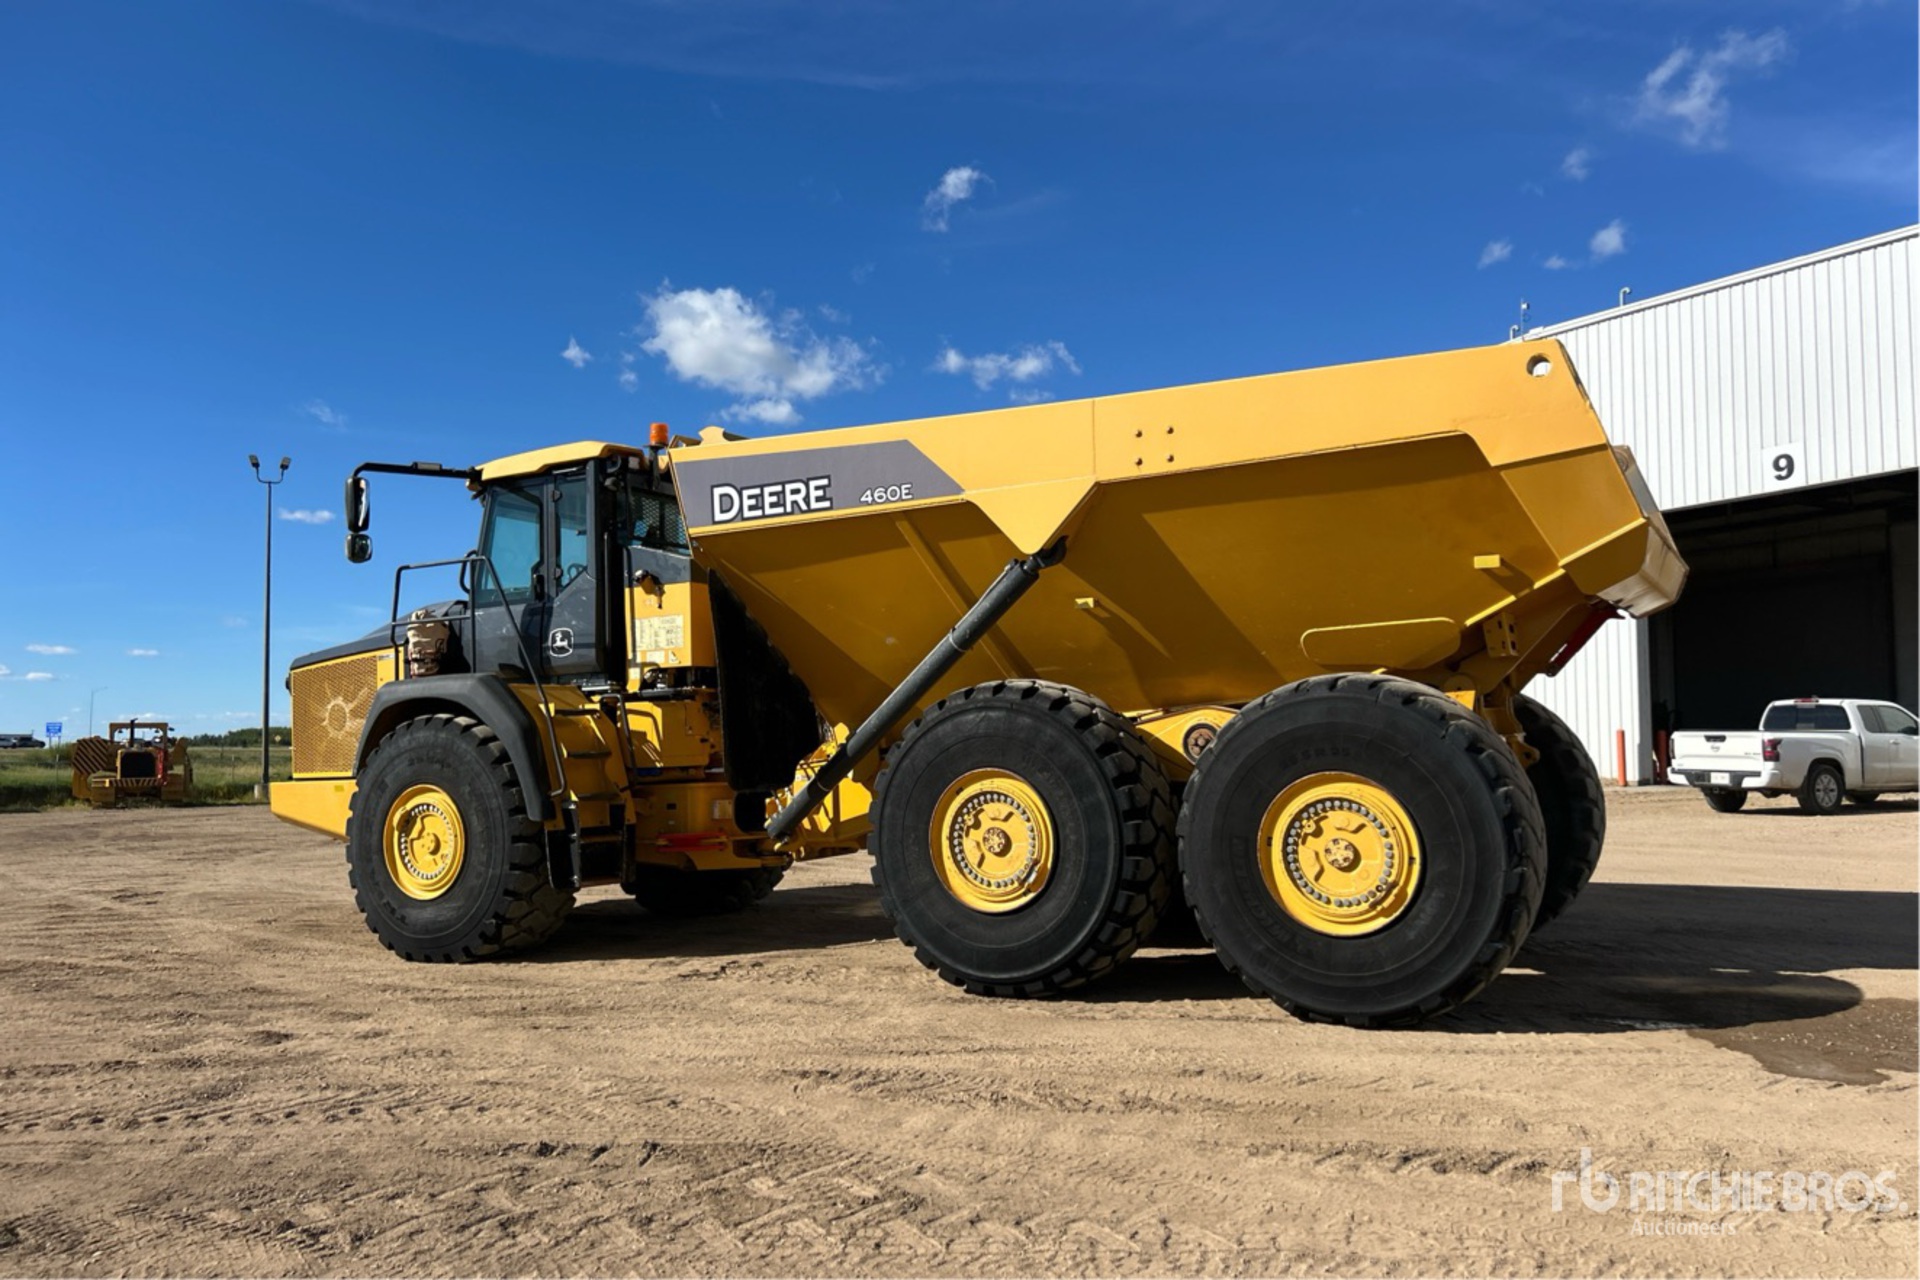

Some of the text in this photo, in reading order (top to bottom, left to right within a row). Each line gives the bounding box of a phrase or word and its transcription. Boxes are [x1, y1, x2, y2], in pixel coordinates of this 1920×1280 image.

[1773, 453, 1795, 481] 9
[711, 476, 914, 524] DEERE 460E
